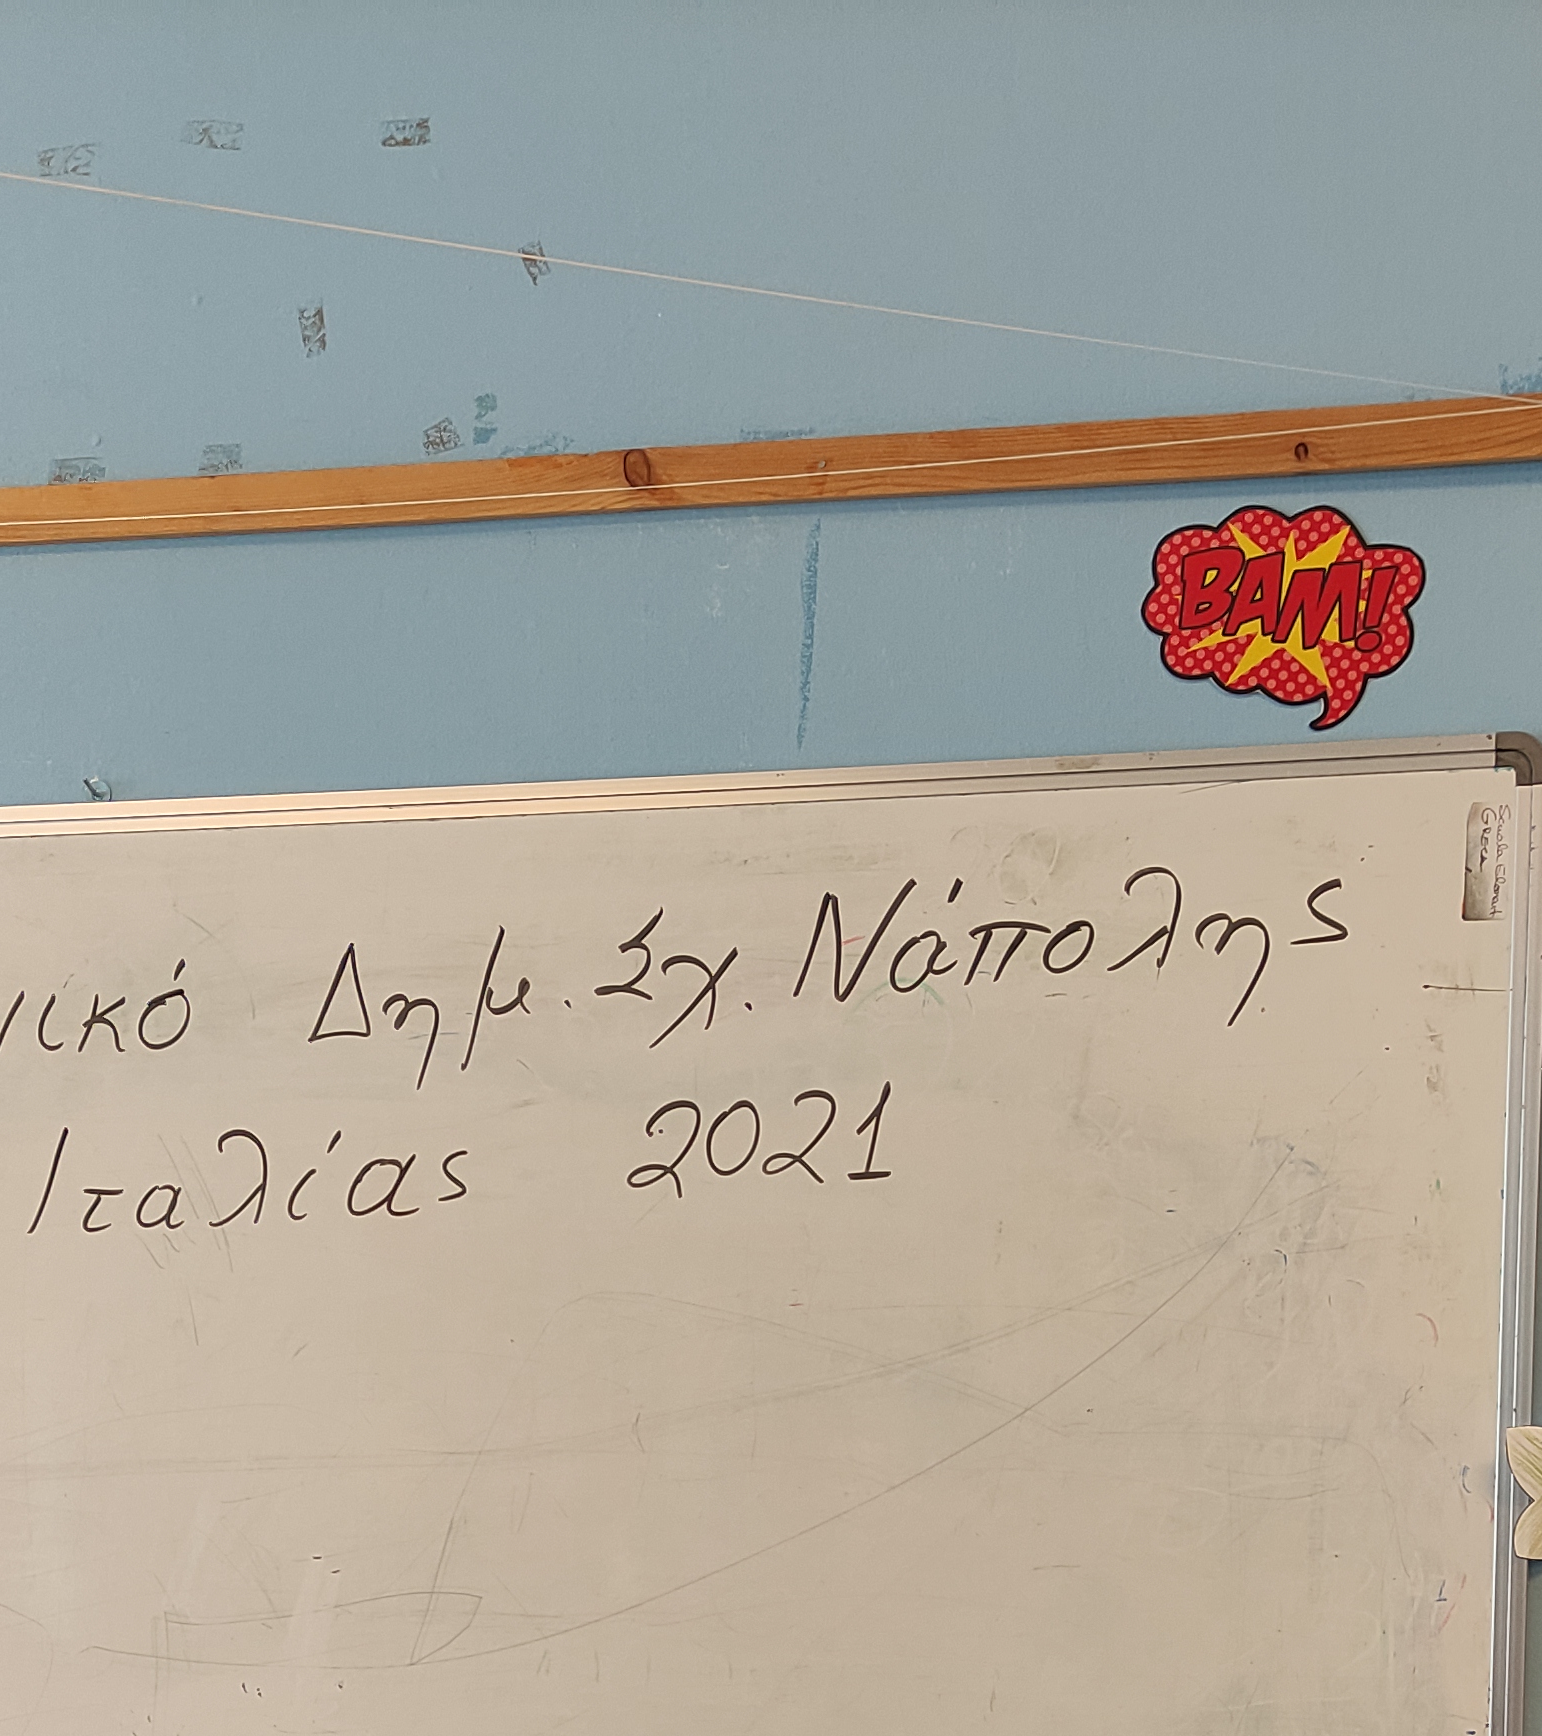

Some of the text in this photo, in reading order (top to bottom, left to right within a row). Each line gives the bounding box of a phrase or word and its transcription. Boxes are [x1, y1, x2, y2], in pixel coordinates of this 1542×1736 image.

[1179, 546, 1399, 652] BAM!
[307, 925, 571, 1090] Δημ.
[791, 865, 1349, 1027] Νάπολης
[28, 1079, 893, 1234] Ιταλίας 2021
